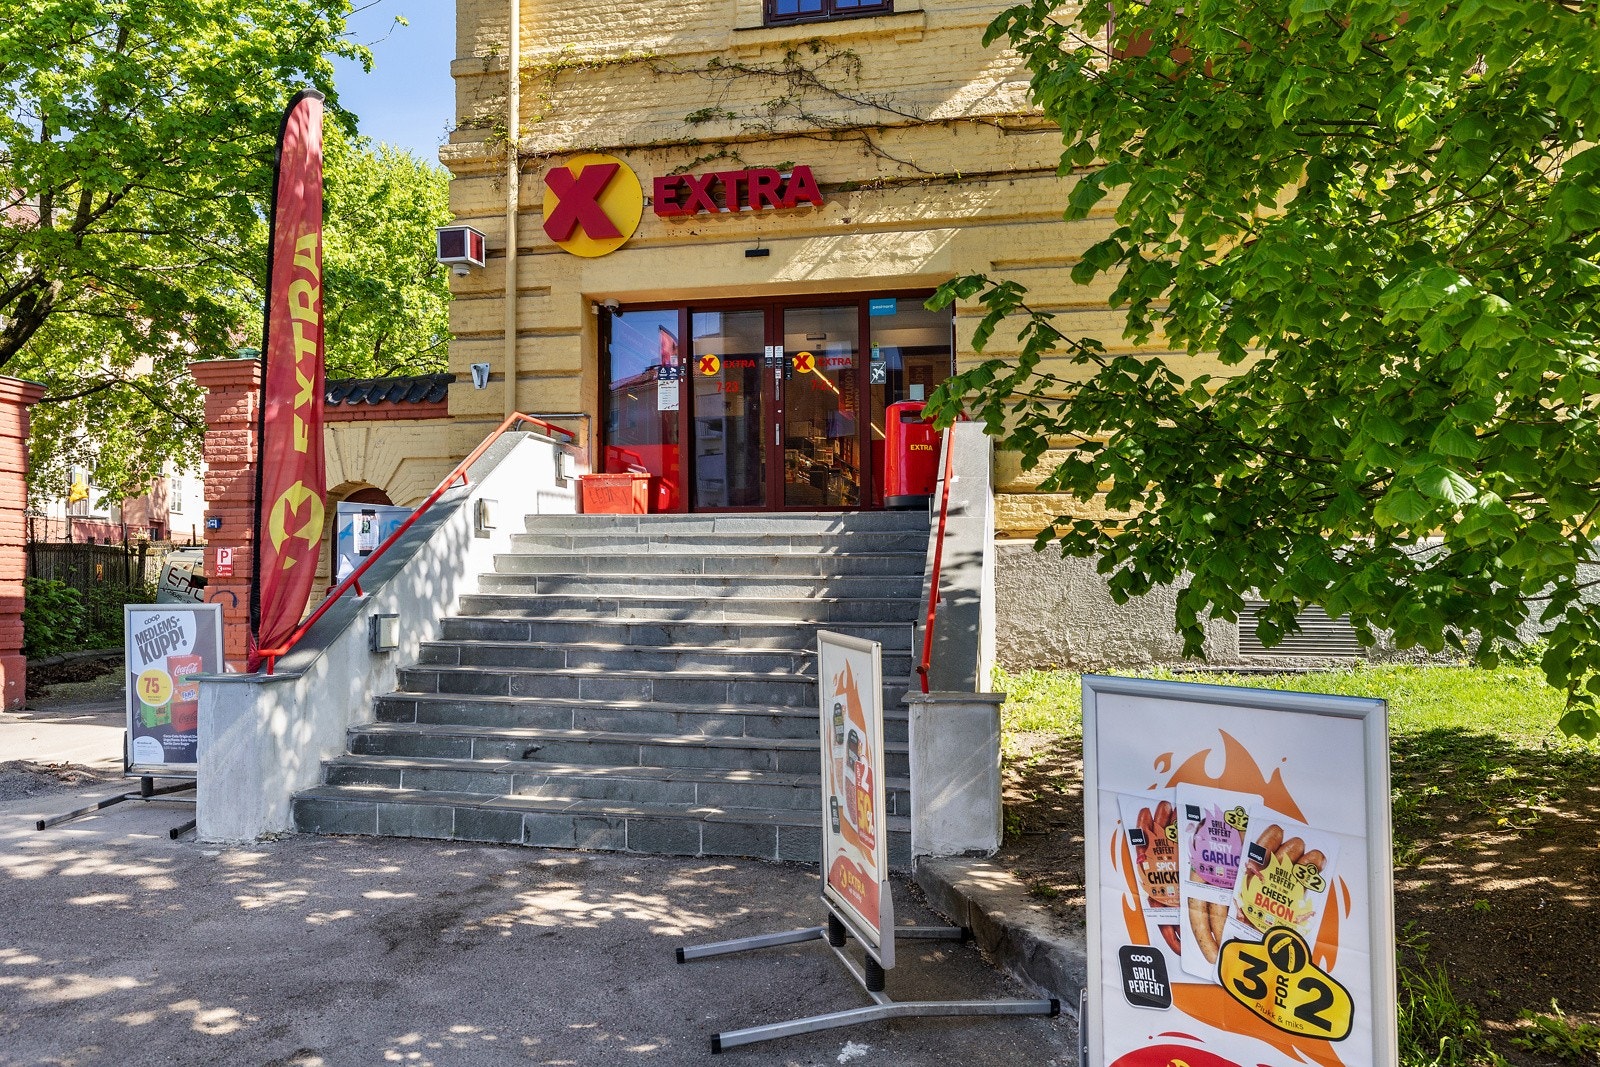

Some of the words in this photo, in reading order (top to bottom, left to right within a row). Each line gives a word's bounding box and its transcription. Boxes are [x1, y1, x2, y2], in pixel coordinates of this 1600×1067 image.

[653, 165, 824, 217] EXTRA
[288, 232, 319, 454] EXTRA
[723, 360, 755, 369] EXTRA
[817, 358, 852, 367] EXTRA
[716, 382, 739, 393] 7-23
[220, 550, 229, 563] P
[144, 614, 160, 625] coop
[134, 615, 180, 646] MEDLEMS-
[138, 626, 187, 666] KUPP!
[144, 677, 160, 694] 75
[1211, 820, 1226, 830] GRILL
[1209, 828, 1231, 838] PERFEKT
[1152, 847, 1174, 855] PERFEKT
[1154, 839, 1169, 848] GRILL
[1209, 842, 1232, 853] TASTY
[1202, 849, 1240, 867] GARLIC
[1156, 862, 1176, 871] SPICY
[1275, 867, 1292, 881] GRILL
[1269, 873, 1296, 890] PERFEKT
[1261, 885, 1294, 907] CHEESY
[1254, 892, 1295, 923] BACON
[1130, 954, 1154, 964] coop
[1132, 966, 1157, 982] GRILL
[1128, 980, 1165, 997] PERFEKT
[1233, 950, 1268, 1000] 3
[1274, 974, 1290, 1009] FOR
[1294, 976, 1335, 1032] 2
[1255, 1002, 1276, 1020] Plukk
[1277, 1015, 1284, 1024] &
[1285, 1017, 1304, 1031] miks
